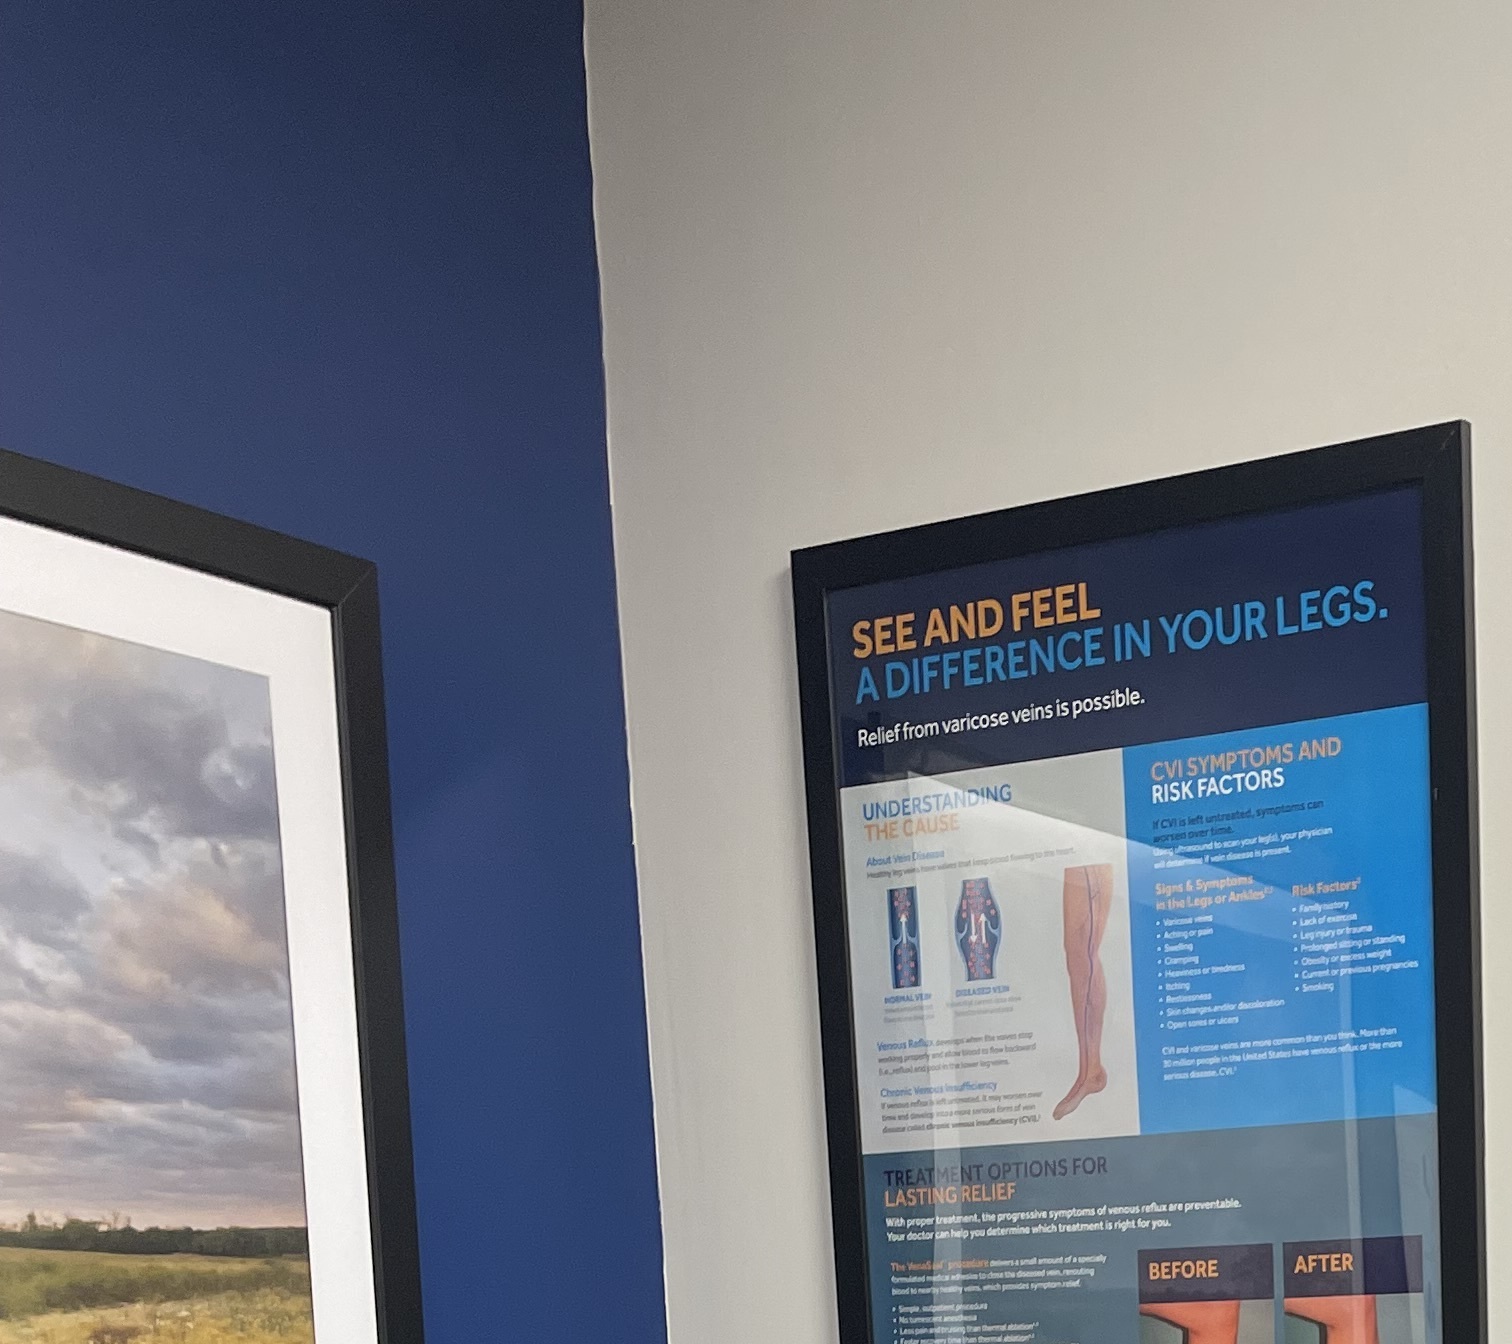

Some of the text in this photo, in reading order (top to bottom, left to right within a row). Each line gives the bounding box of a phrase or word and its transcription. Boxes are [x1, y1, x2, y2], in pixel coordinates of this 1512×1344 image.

[853, 583, 1101, 659] SEE AND FEEL
[856, 580, 1388, 704] A DIFFERENCE IN YOUR LEGS.
[857, 687, 1146, 748] Relief from varicose veins is possible.
[1151, 736, 1342, 782] CVI SYMPTOMS AND
[1152, 767, 1285, 804] RISK FACTORS
[863, 784, 1011, 820] UNDERSTANDING
[1188, 813, 1204, 825] left
[1256, 803, 1305, 818] symptoms
[1307, 800, 1324, 811] can
[864, 813, 959, 842] THE CAUSE
[1188, 829, 1209, 840] over
[866, 855, 892, 867] About
[1155, 875, 1254, 896] Signs & Symptoms
[1292, 881, 1315, 897] Risk
[1168, 897, 1185, 909] the
[1187, 894, 1213, 909] Legs
[1214, 893, 1227, 904] or
[1300, 916, 1317, 927] Lack
[1300, 930, 1315, 941] Leg
[1302, 981, 1335, 993] Smoking
[884, 1156, 1109, 1187] TREATMENT OPTIONS FOR
[884, 1182, 1017, 1208] LASTING RELIEF
[885, 1197, 1242, 1229] With proper treatment, the progressive symptoms of venous reflux are preventable.
[886, 1216, 1171, 1243] Your doctor can help you determine which treatment is right for you.
[1149, 1253, 1354, 1281] BEFORE AFTER
